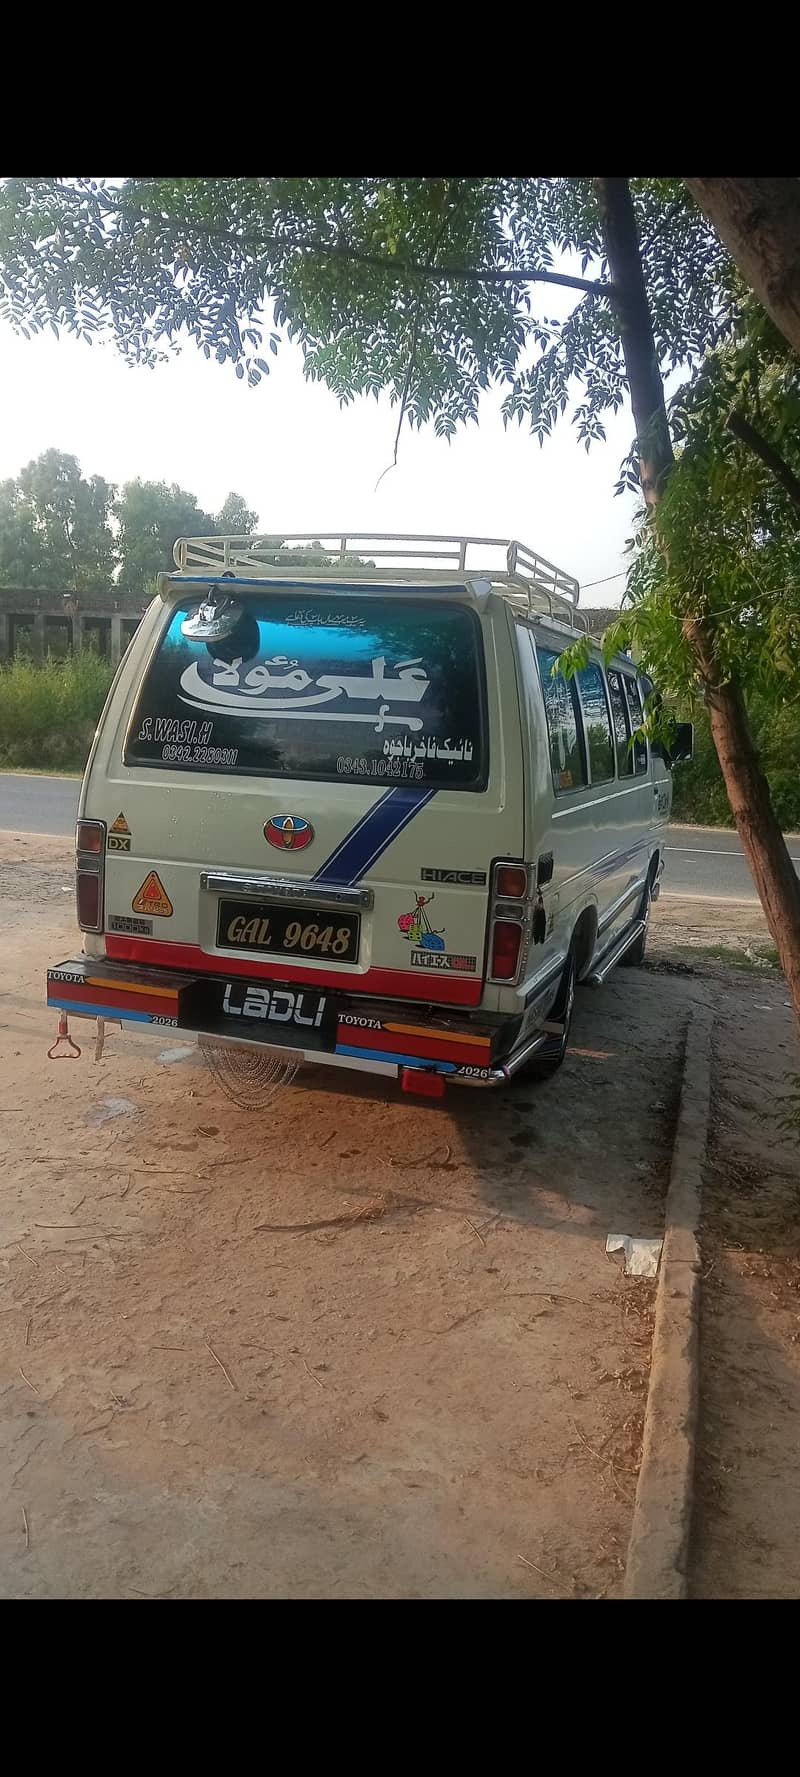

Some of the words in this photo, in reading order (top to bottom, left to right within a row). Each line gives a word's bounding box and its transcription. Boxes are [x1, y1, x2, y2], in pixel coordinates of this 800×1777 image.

[108, 837, 129, 851] DX
[422, 869, 487, 884] HIACE
[227, 916, 272, 945] GAL
[283, 921, 351, 954] 9648
[47, 971, 85, 984] TOYOTA
[152, 1016, 178, 1027] 2026
[338, 1014, 382, 1030] TOYOTA
[457, 1066, 489, 1079] 2026
